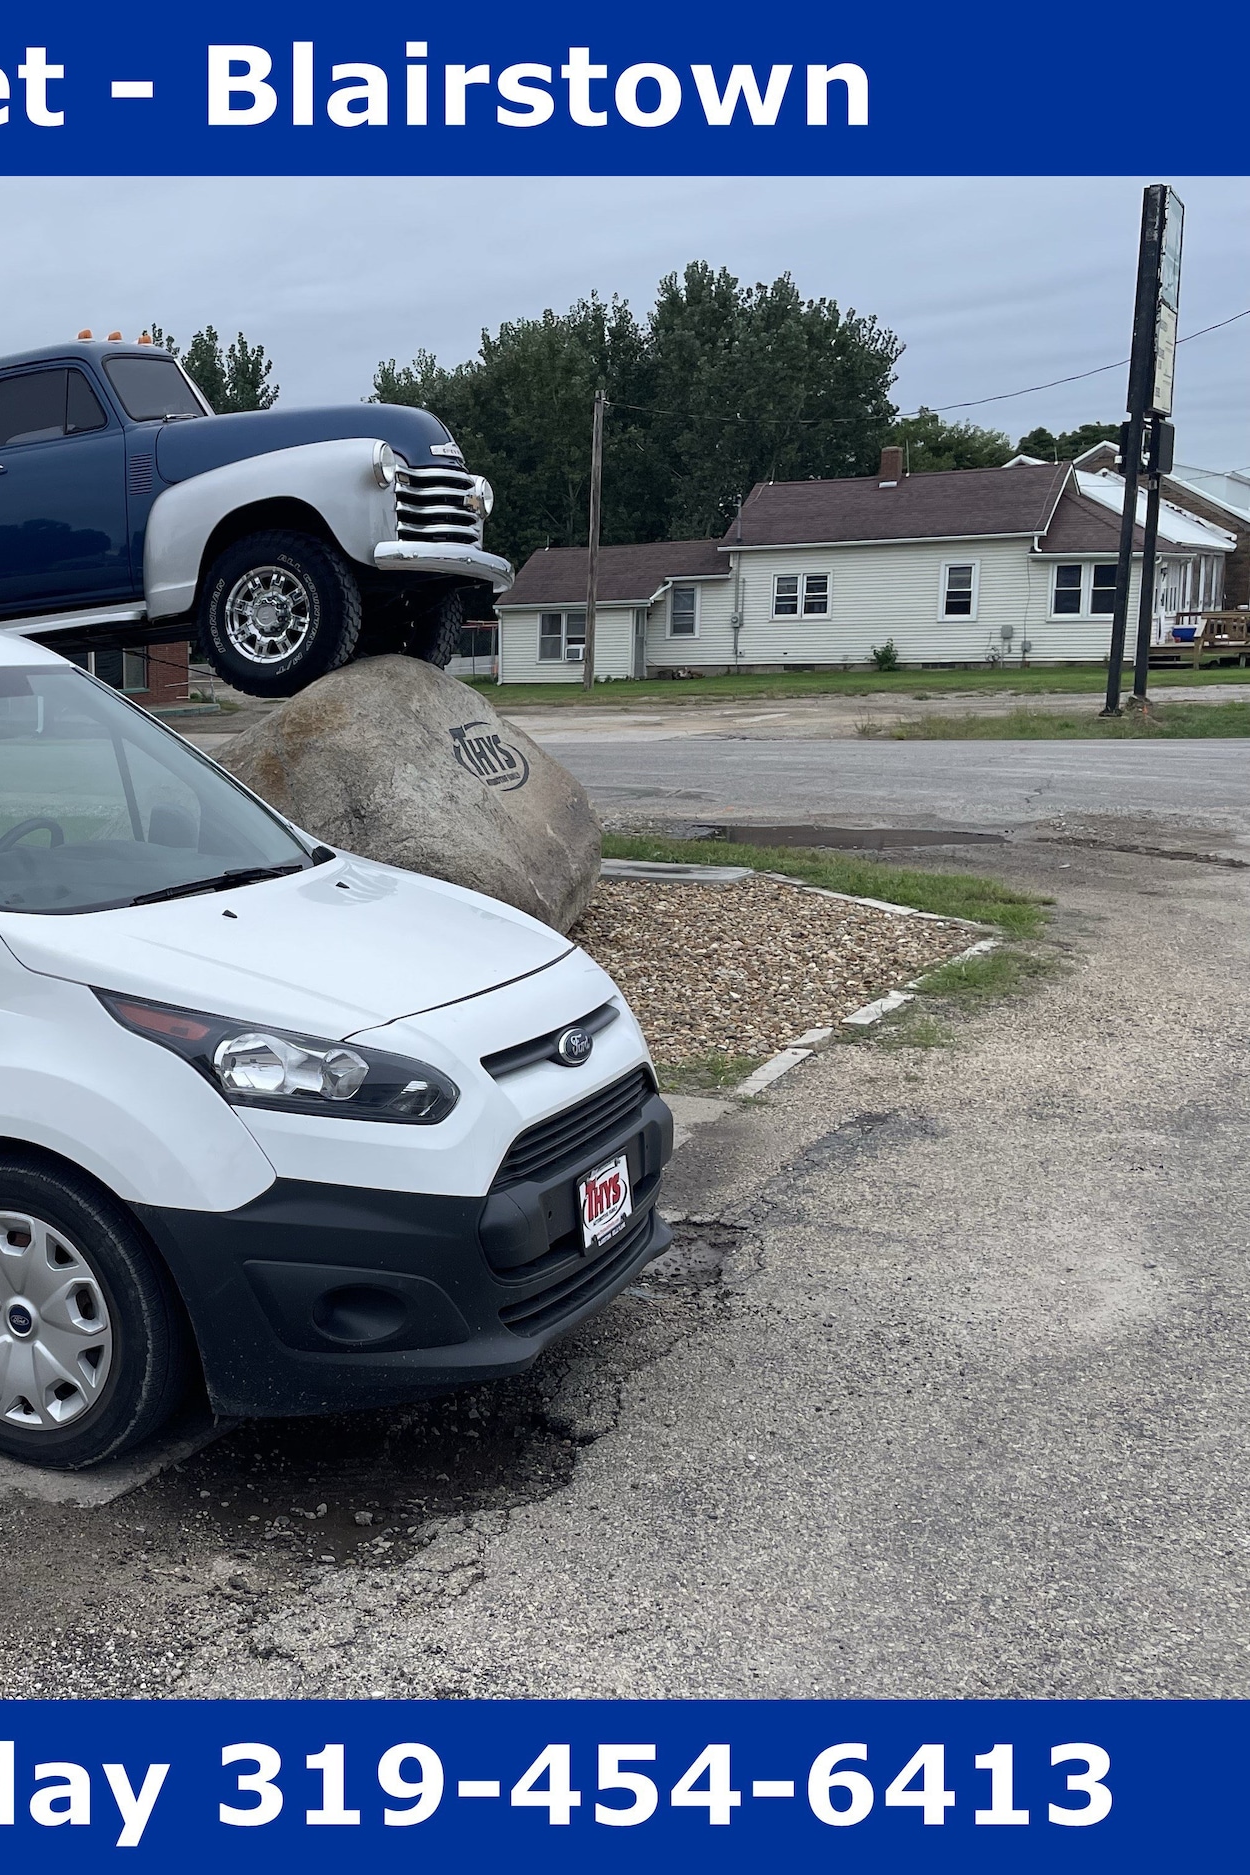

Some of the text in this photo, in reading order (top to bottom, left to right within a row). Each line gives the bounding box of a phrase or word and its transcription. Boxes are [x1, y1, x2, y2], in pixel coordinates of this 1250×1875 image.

[209, 578, 227, 654] IRONMAN
[448, 725, 518, 777] THYS
[570, 1033, 591, 1056] Ford
[585, 1172, 621, 1223] THYS
